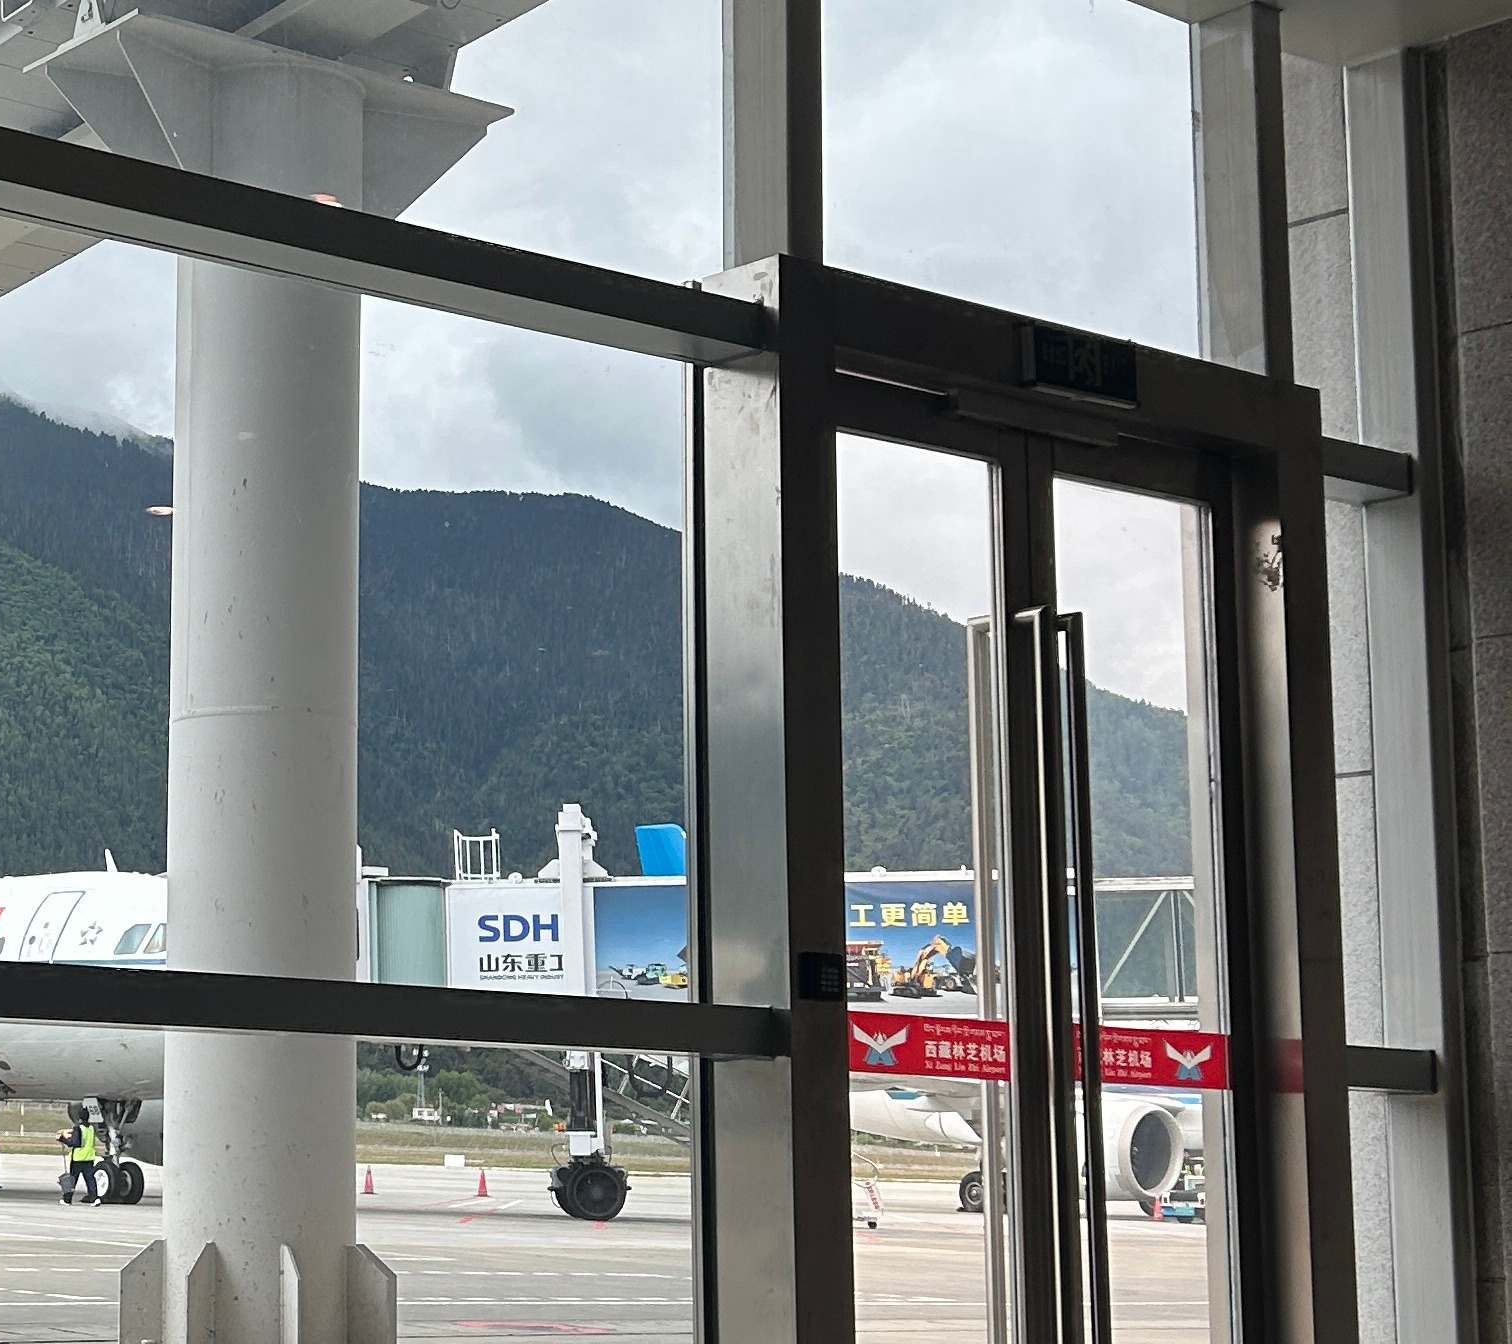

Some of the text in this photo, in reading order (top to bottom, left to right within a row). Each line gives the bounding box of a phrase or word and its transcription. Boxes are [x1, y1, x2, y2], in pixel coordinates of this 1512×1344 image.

[849, 901, 970, 927] 工更简单
[477, 913, 560, 943] SDH
[479, 952, 564, 973] 山东重工
[924, 1040, 1006, 1064] 西藏林芝机场
